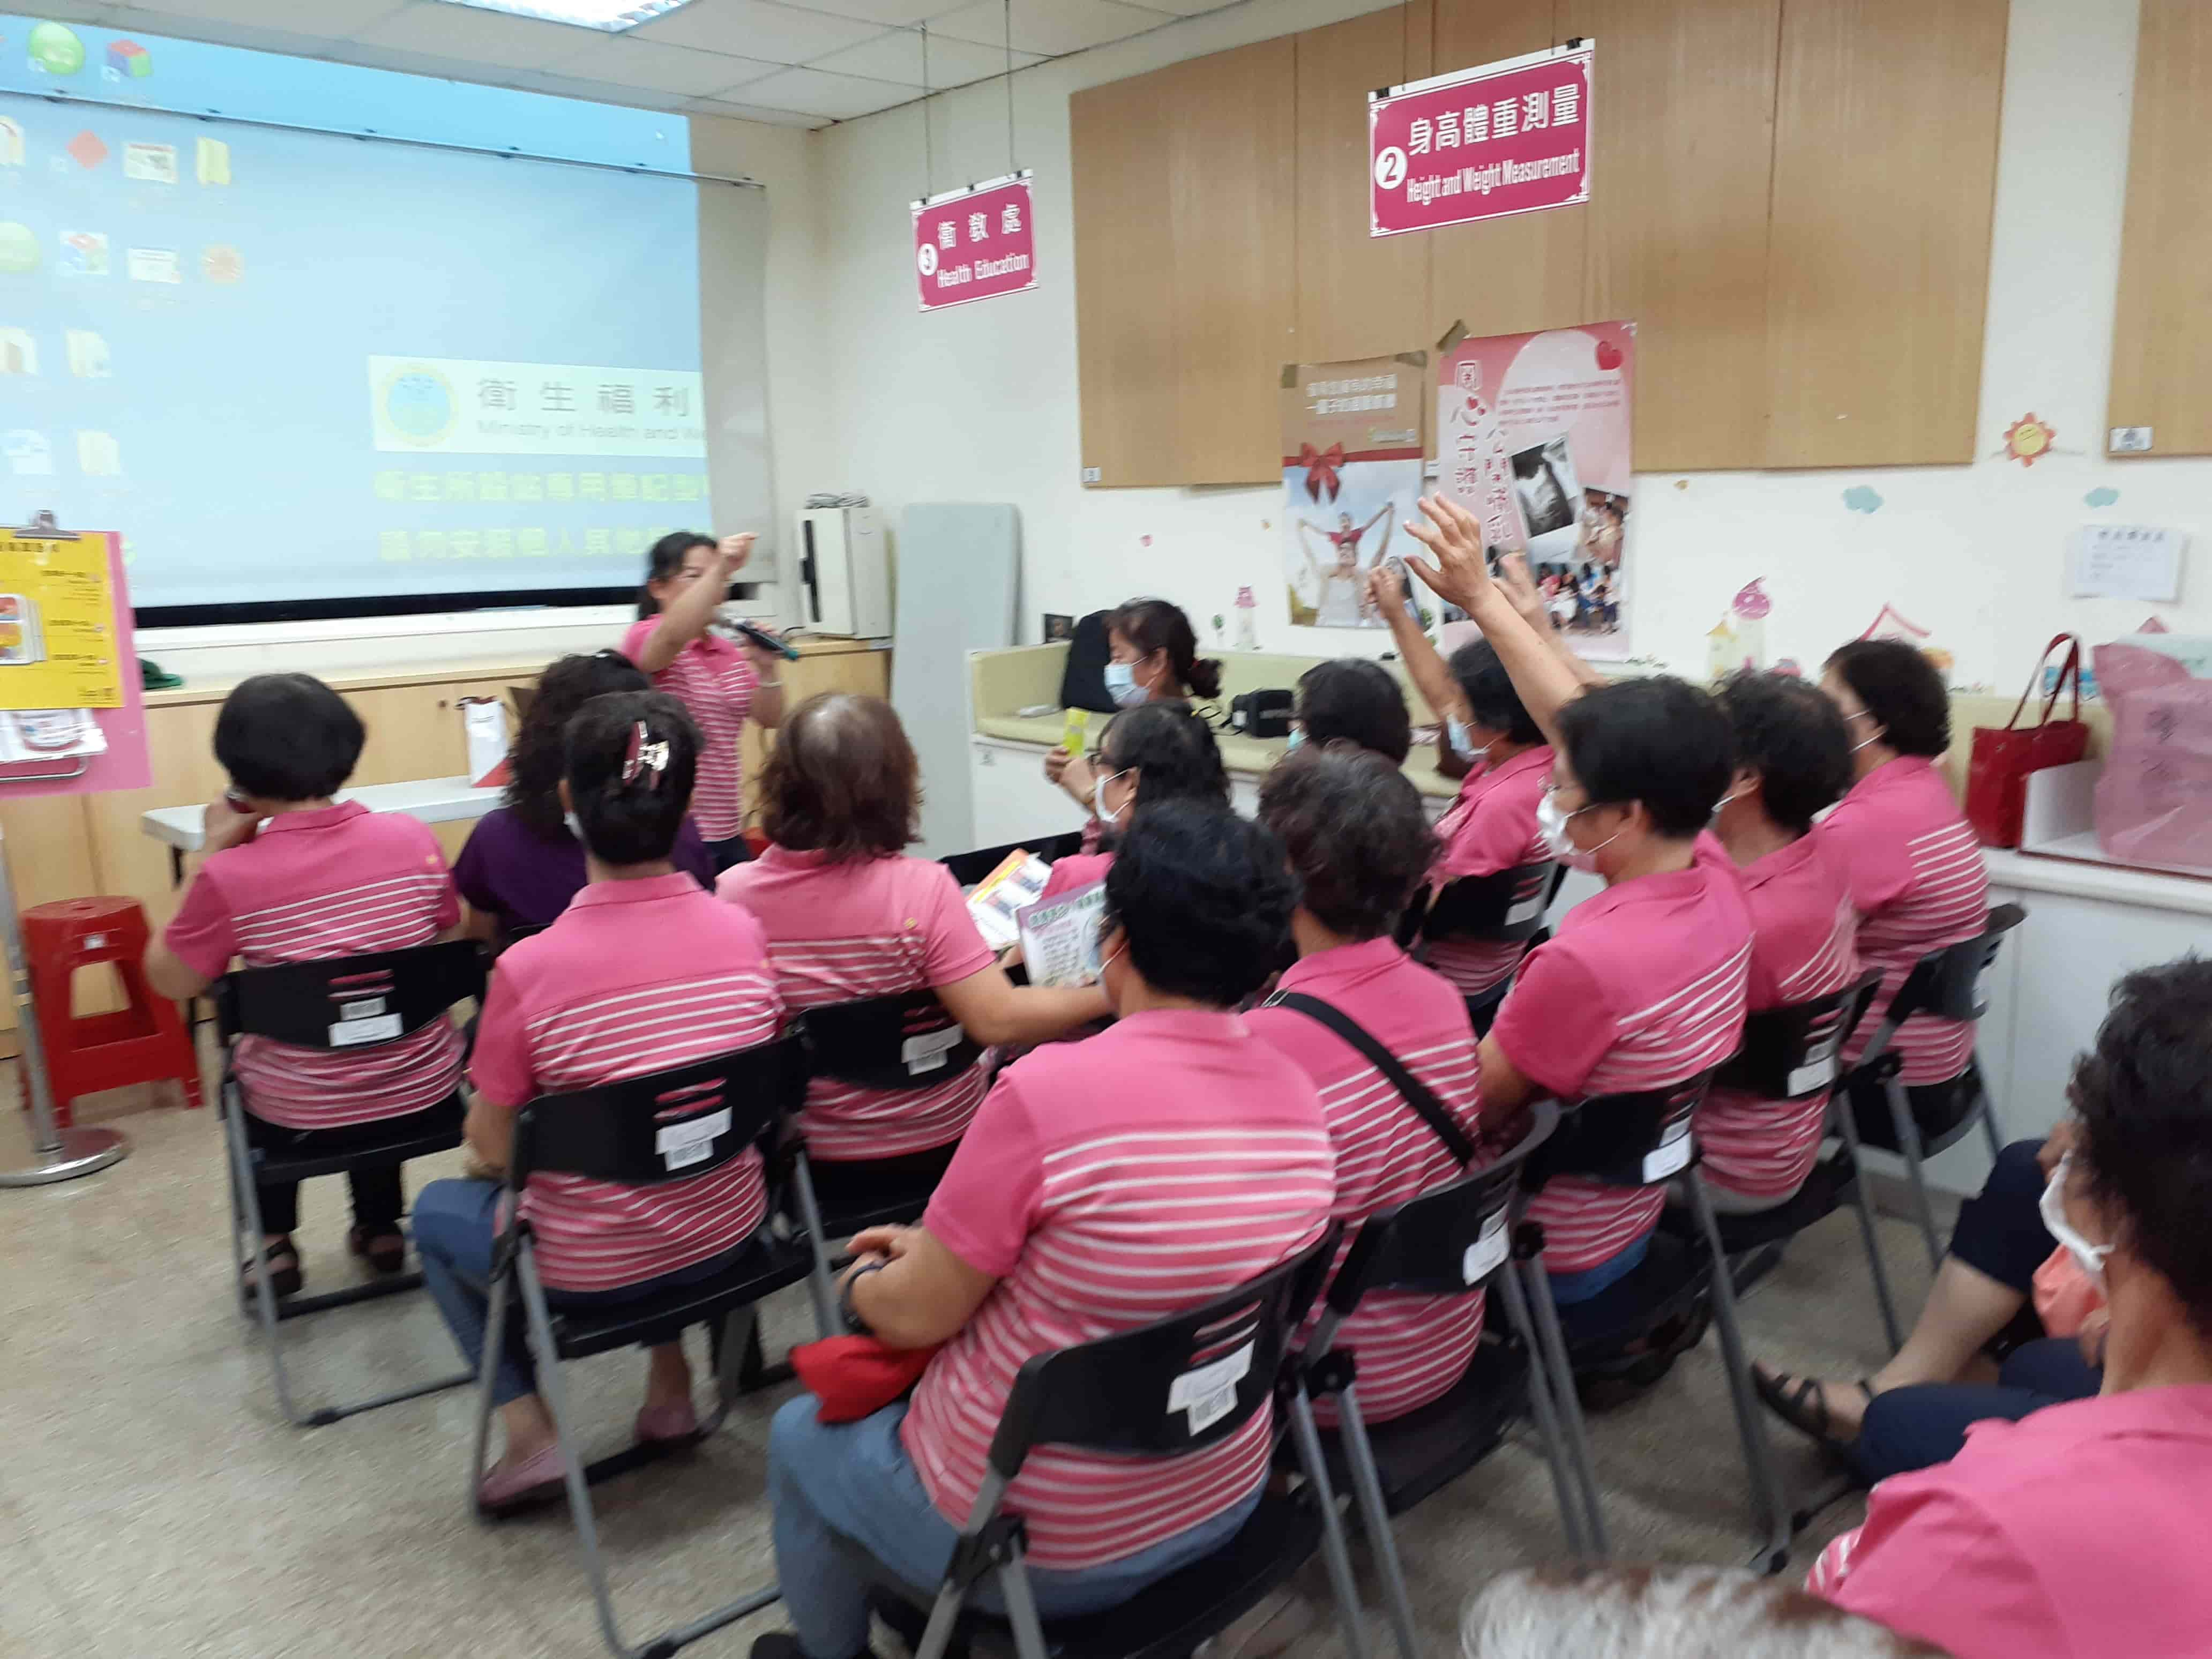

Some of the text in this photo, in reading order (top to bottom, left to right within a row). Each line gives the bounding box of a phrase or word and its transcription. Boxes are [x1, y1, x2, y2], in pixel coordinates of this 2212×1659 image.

[1408, 84, 1581, 156] 身高體重測量
[1383, 151, 1398, 183] 2
[1406, 147, 1580, 206] Height and Weight Measurement
[937, 252, 1029, 288] Health Education
[477, 377, 690, 417] 衛生福利
